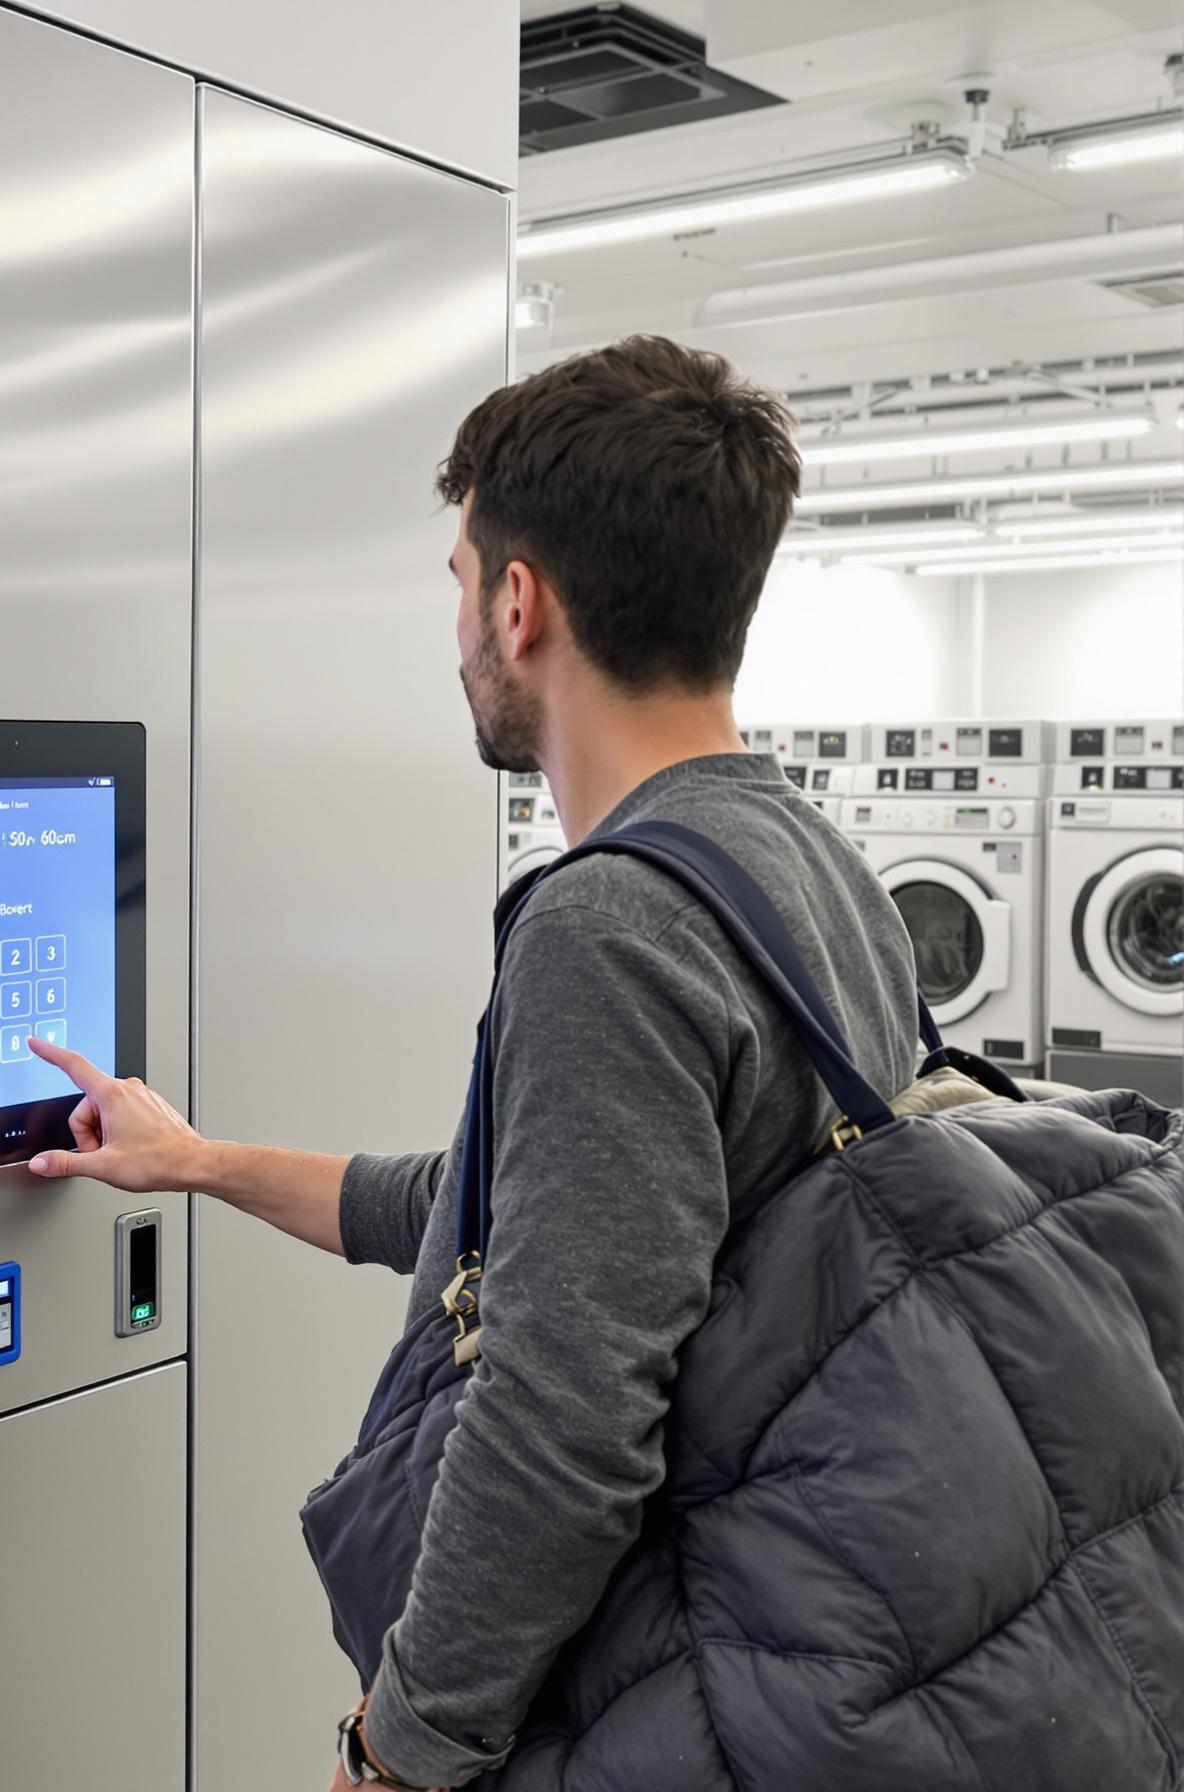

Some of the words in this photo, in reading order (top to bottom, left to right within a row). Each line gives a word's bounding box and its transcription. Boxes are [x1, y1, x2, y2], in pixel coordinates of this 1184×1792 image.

[10, 949, 21, 966] 2
[46, 946, 56, 961] 3
[11, 992, 21, 1008] 5
[46, 988, 56, 1004] 6
[11, 1035, 21, 1051] 8
